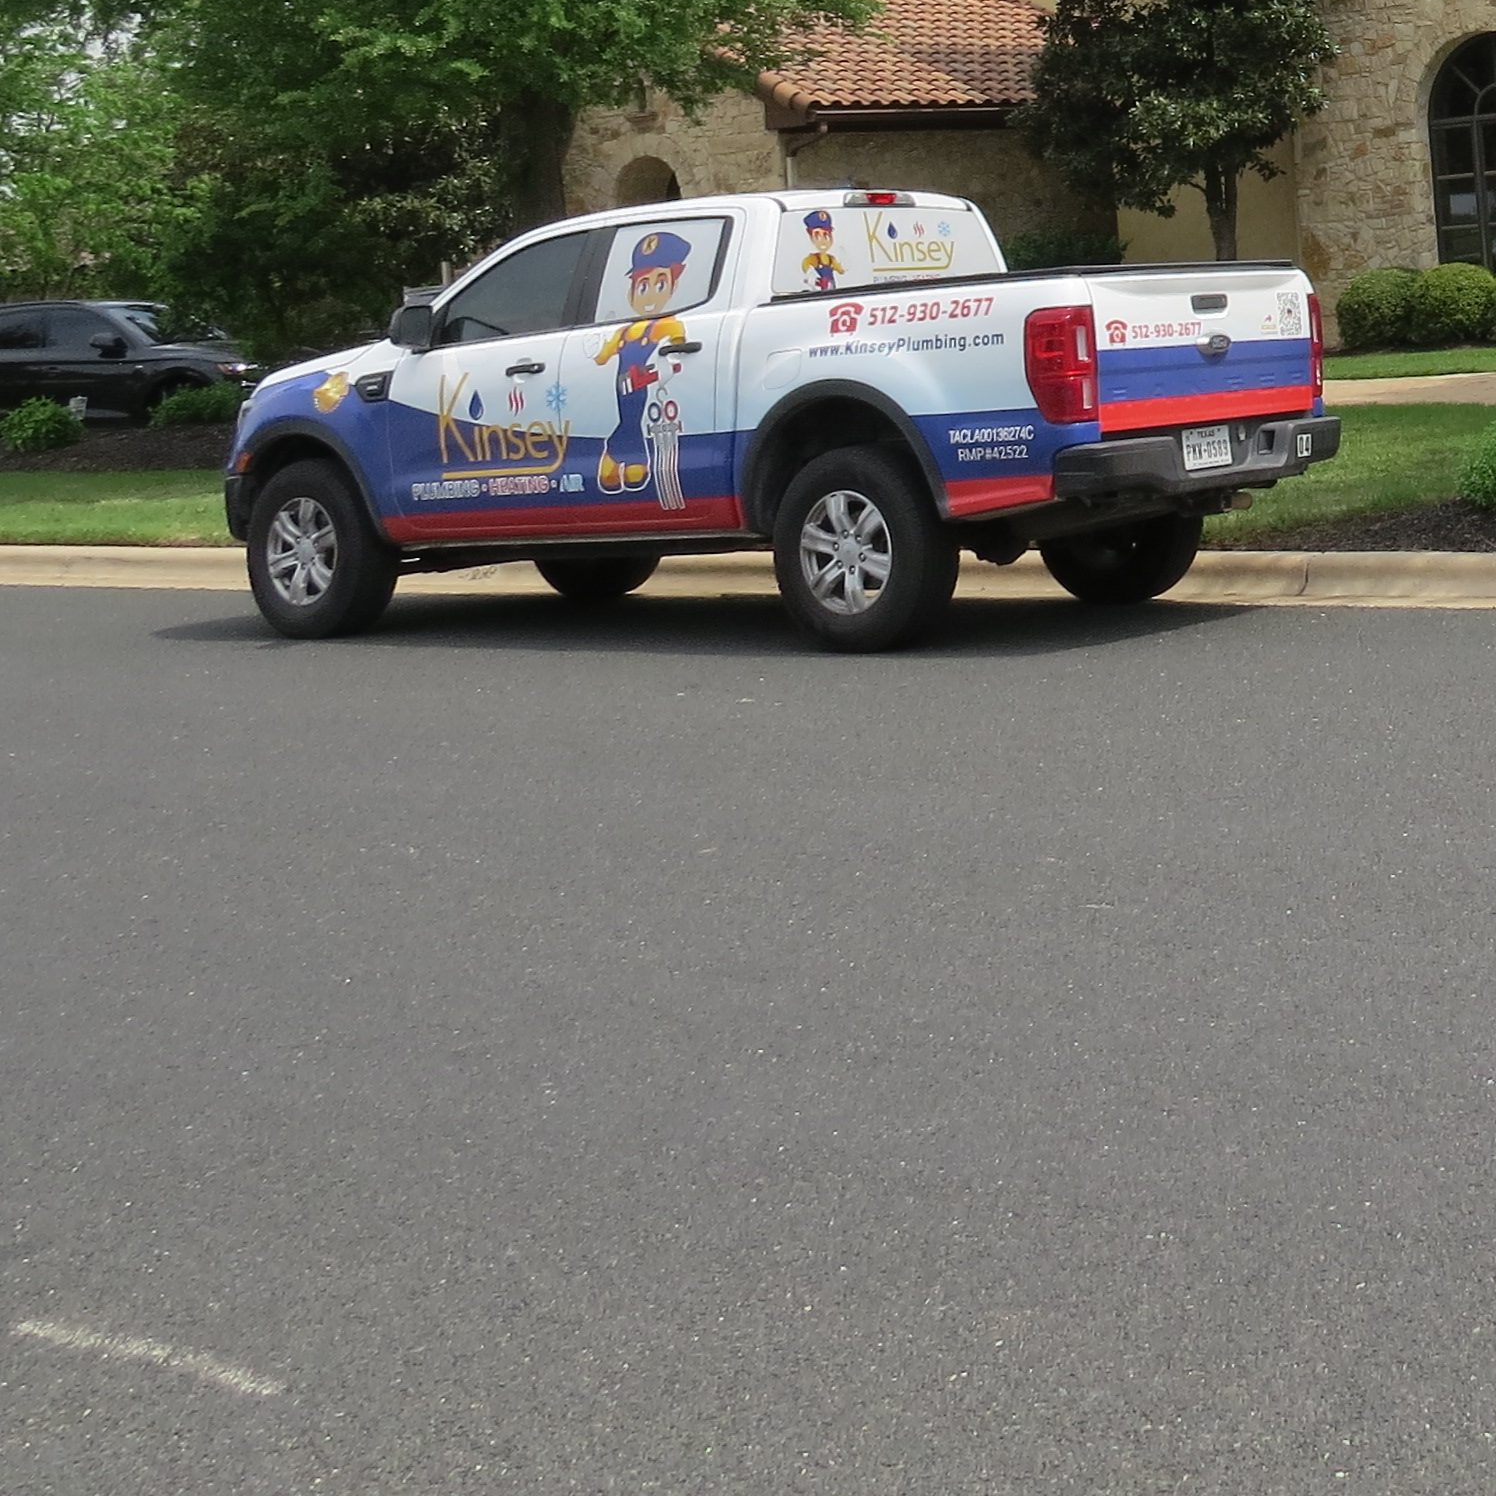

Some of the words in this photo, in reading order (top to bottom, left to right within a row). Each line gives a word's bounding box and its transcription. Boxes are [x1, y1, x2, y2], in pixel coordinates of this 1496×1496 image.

[644, 237, 656, 252] K
[863, 211, 955, 271] Kinsey
[867, 297, 994, 326] 512-930-2677
[1131, 321, 1202, 340] 512-930-2677
[808, 331, 1005, 358] www.KinseyPlumbing.com
[438, 372, 571, 475] Kinsey
[957, 444, 1029, 461] RMP#42522
[411, 479, 481, 501] PLUMBING
[488, 475, 550, 497] HEATING
[559, 473, 585, 493] AIR
